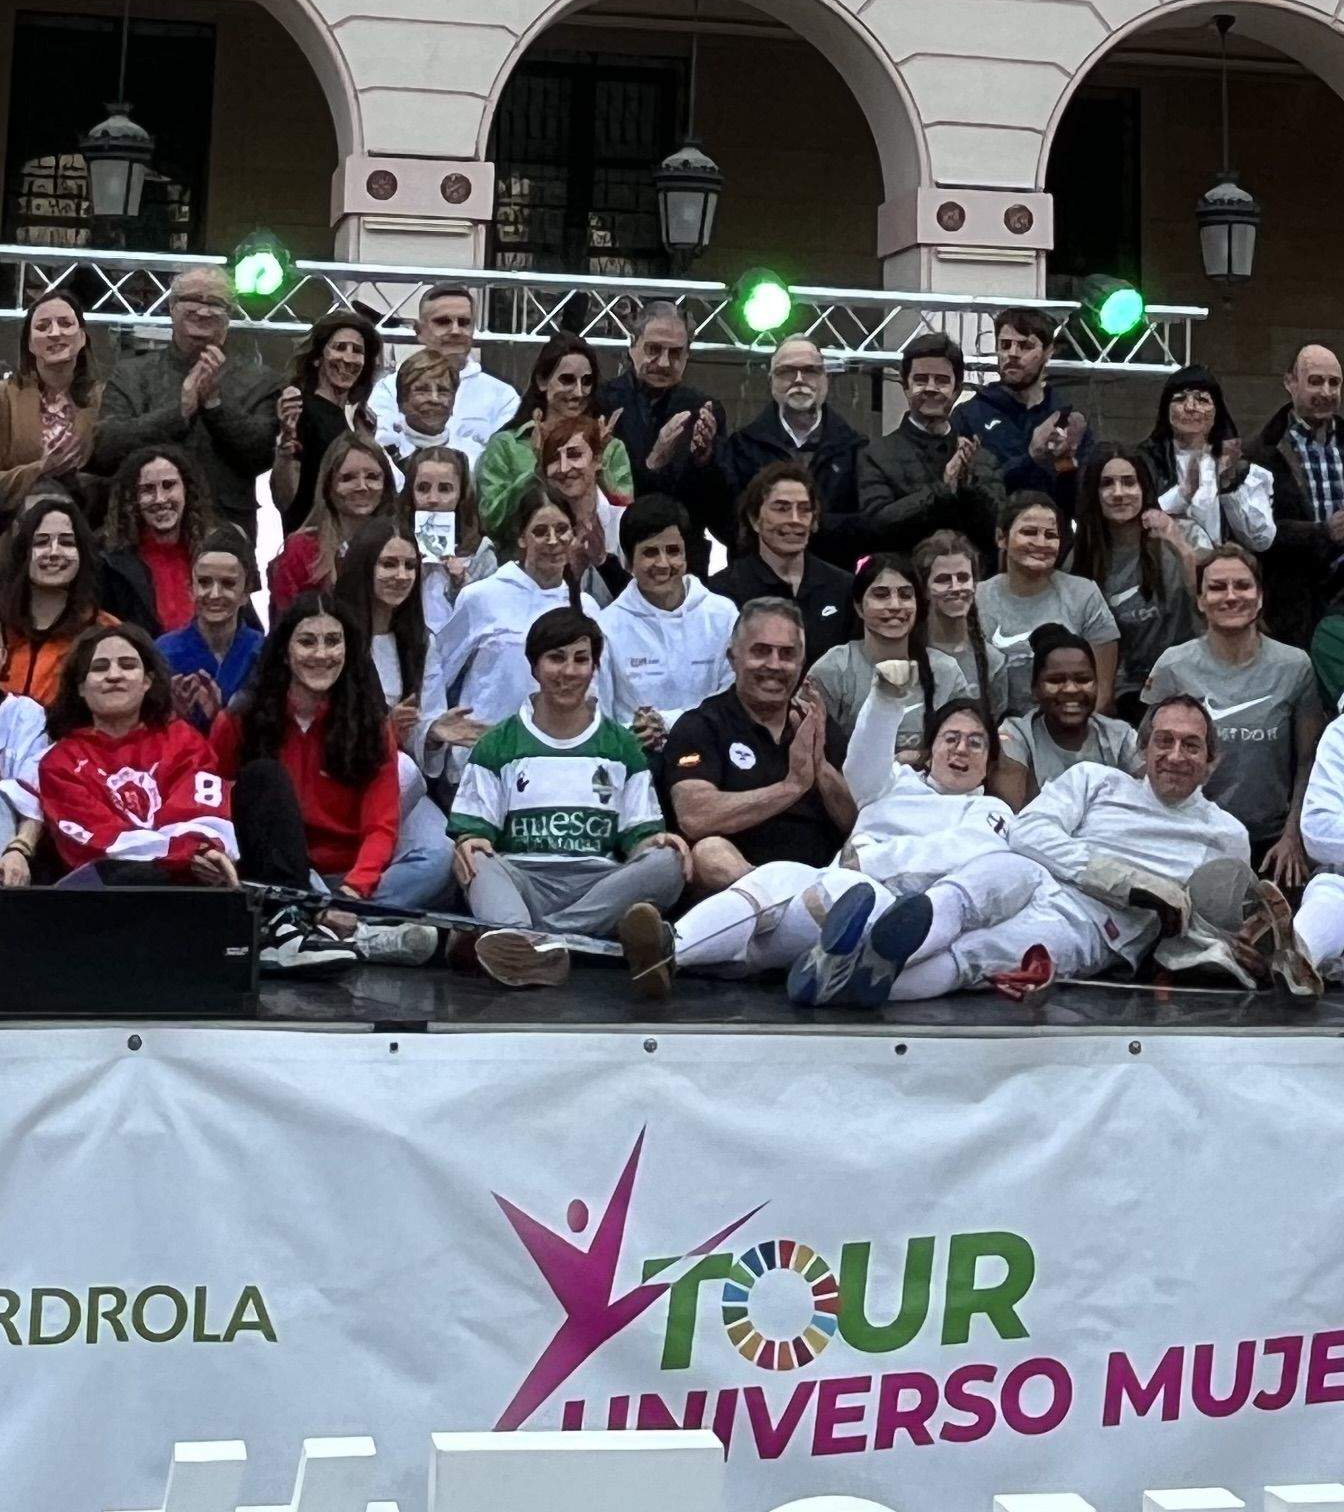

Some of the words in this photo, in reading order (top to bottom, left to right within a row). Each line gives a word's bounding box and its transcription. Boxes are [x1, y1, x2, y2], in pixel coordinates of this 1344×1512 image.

[194, 761, 223, 808] 8
[511, 811, 613, 838] Huesca
[641, 1230, 1037, 1372] TOUR
